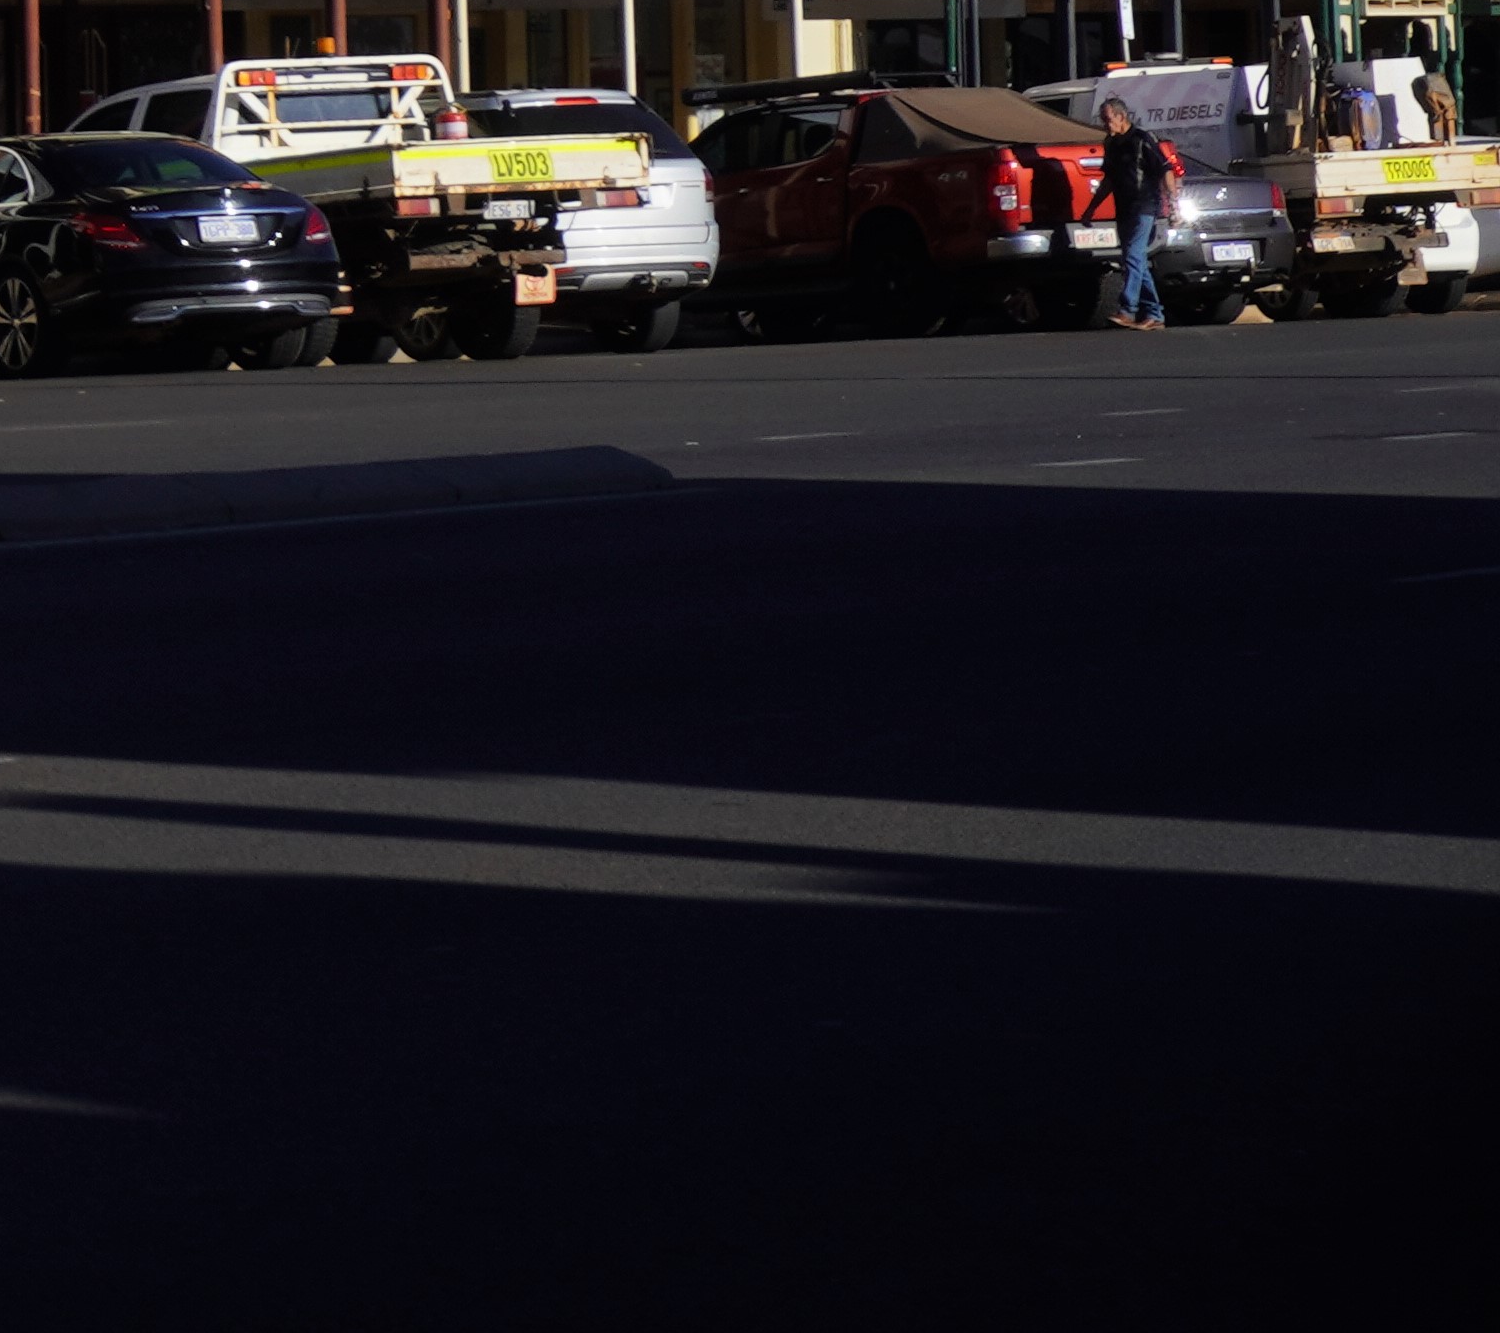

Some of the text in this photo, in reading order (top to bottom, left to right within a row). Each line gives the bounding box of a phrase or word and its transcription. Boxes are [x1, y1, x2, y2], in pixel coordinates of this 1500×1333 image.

[1147, 108, 1164, 122] TR
[1167, 103, 1224, 122] DIESELS
[493, 151, 550, 178] LV503
